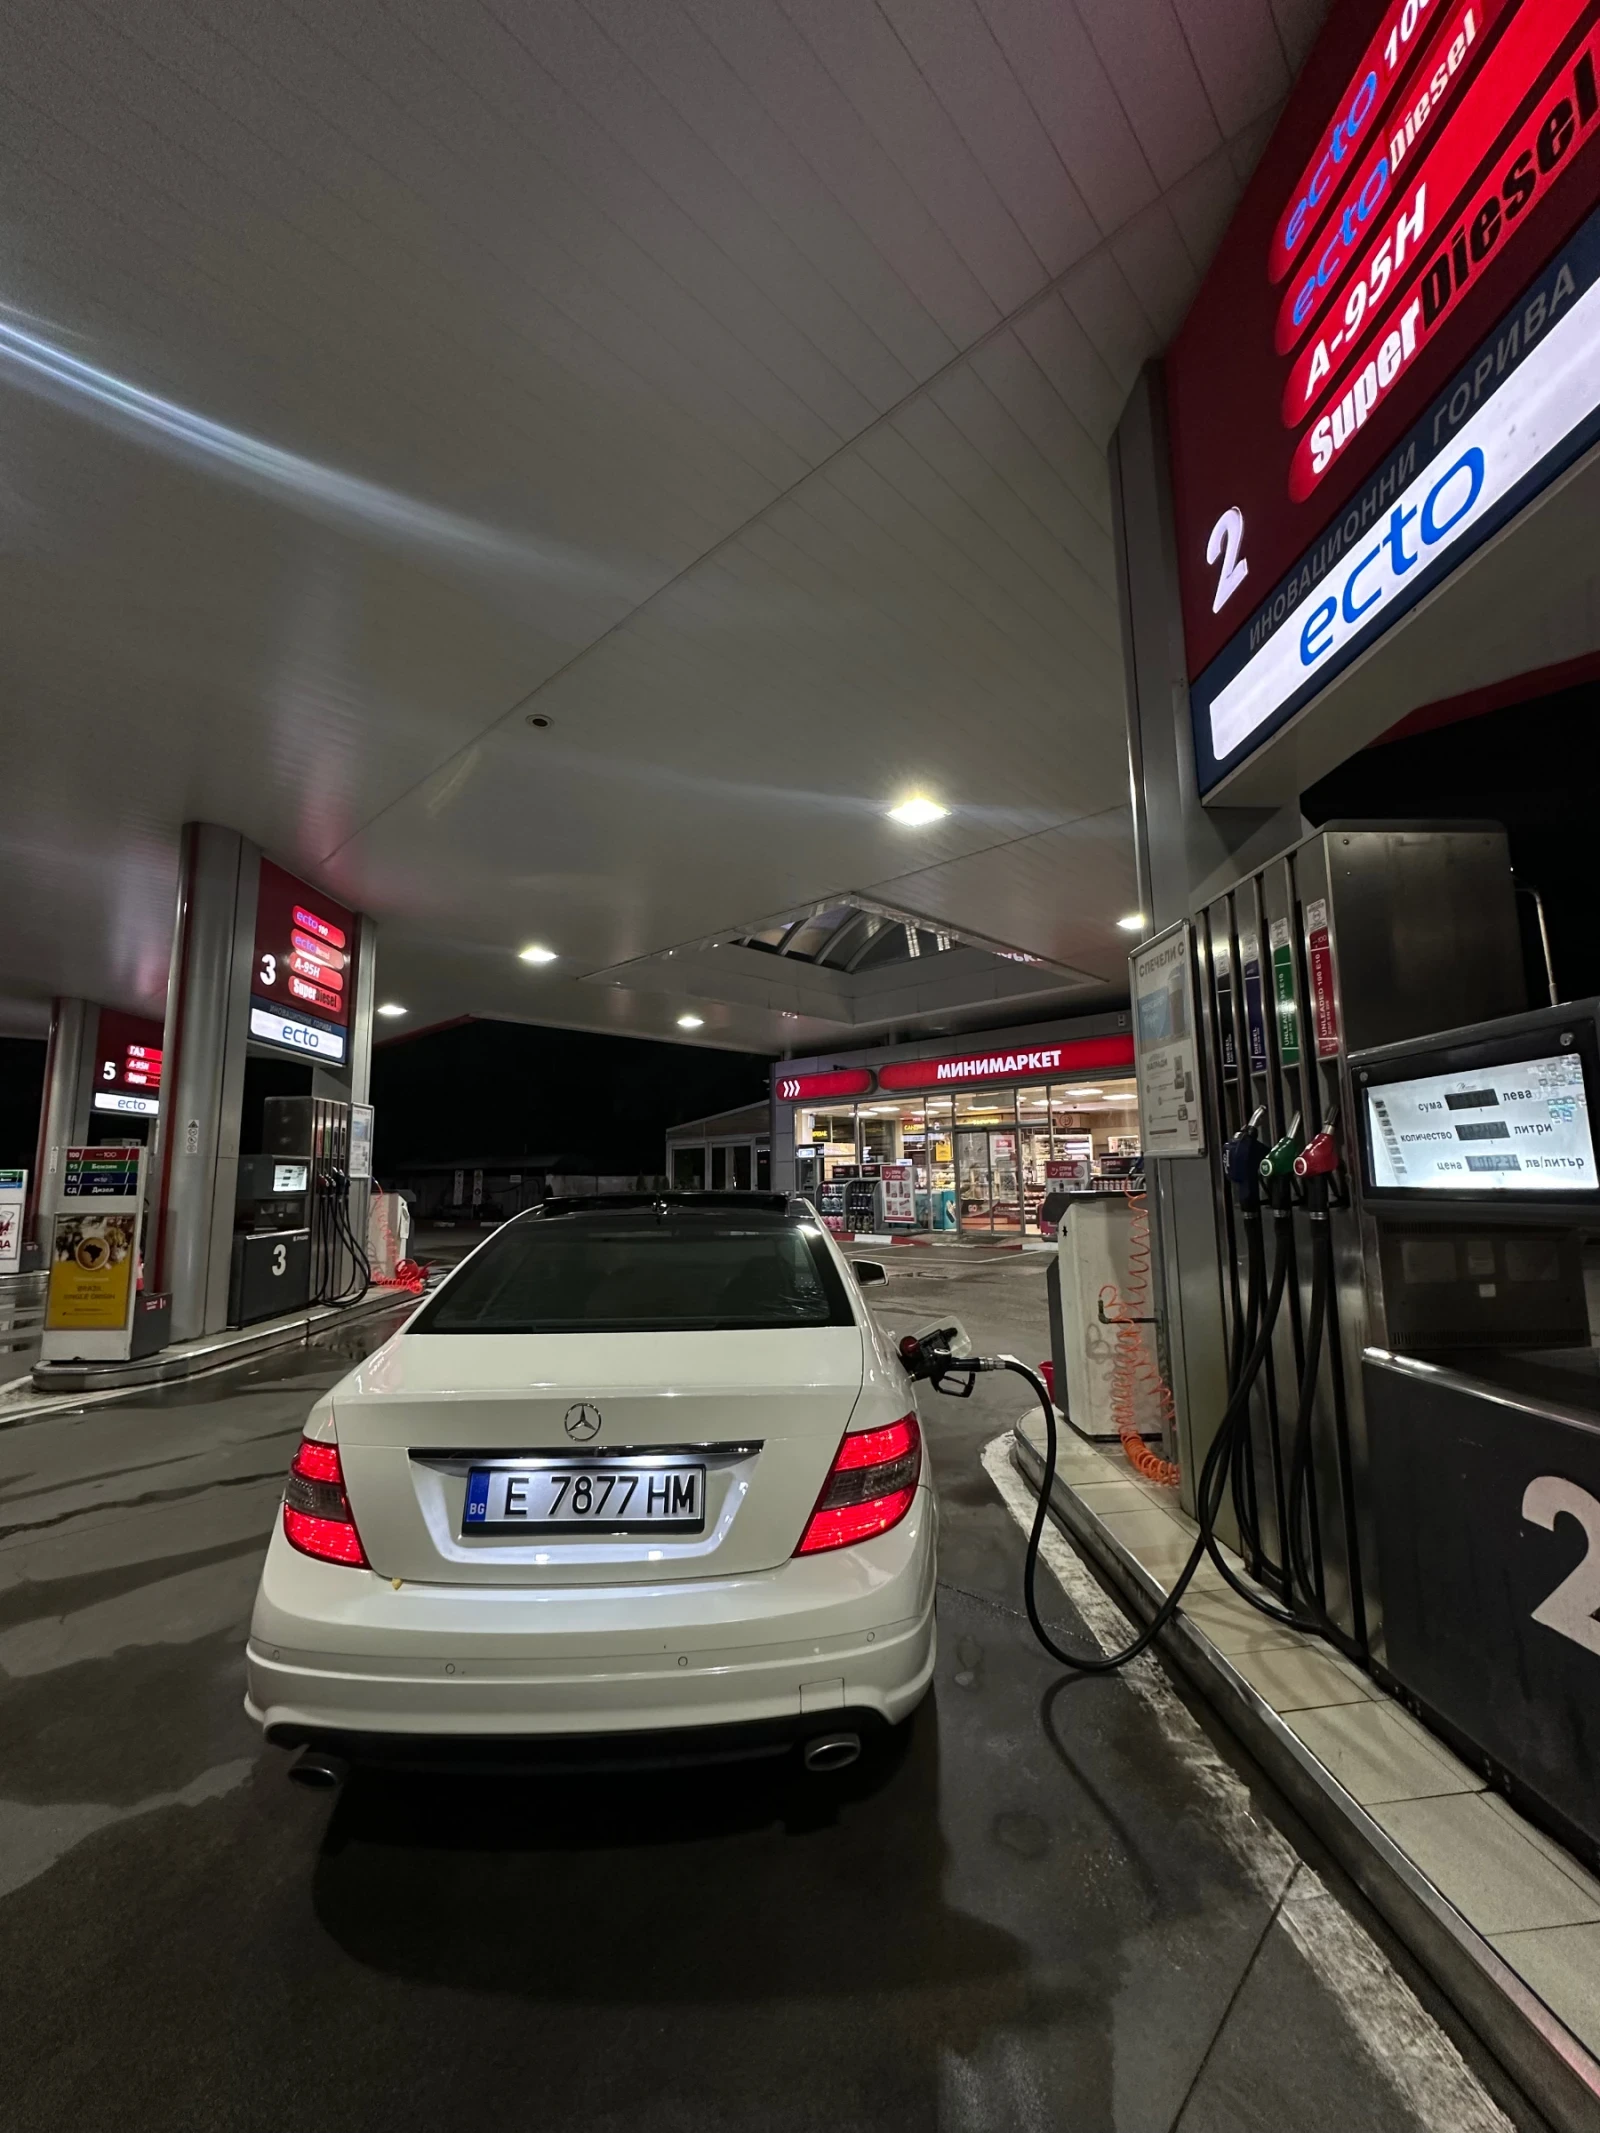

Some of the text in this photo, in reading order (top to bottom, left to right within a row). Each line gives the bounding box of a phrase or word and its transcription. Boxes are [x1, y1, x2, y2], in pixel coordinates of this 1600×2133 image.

[1285, 71, 1377, 250] ecto
[1250, 263, 1576, 651] ИНОВАЦИОННИ ГОРИВА
[1206, 506, 1249, 615] 2
[1300, 447, 1485, 667] ecto
[296, 911, 318, 929] ecto
[259, 953, 277, 986] 3
[1139, 946, 1177, 978] СПЕЧЕЛИ
[1317, 987, 1328, 1037] UNLEADED
[282, 1025, 319, 1048] ecto
[102, 1061, 116, 1081] 5
[937, 1050, 1062, 1079] МИНИМАРКЕТ
[117, 1098, 147, 1111] ecto
[1418, 1101, 1443, 1112] сума
[1503, 1088, 1533, 1102] лева
[1400, 1129, 1453, 1143] количество
[1514, 1123, 1553, 1135] литри
[69, 1151, 80, 1159] 100
[1437, 1160, 1463, 1171] цена
[91, 1186, 115, 1194] Дизел
[272, 1244, 287, 1276] 3
[469, 1503, 485, 1515] BG
[504, 1474, 696, 1516] E 7877 HM
[1522, 1475, 1600, 1657] 2
